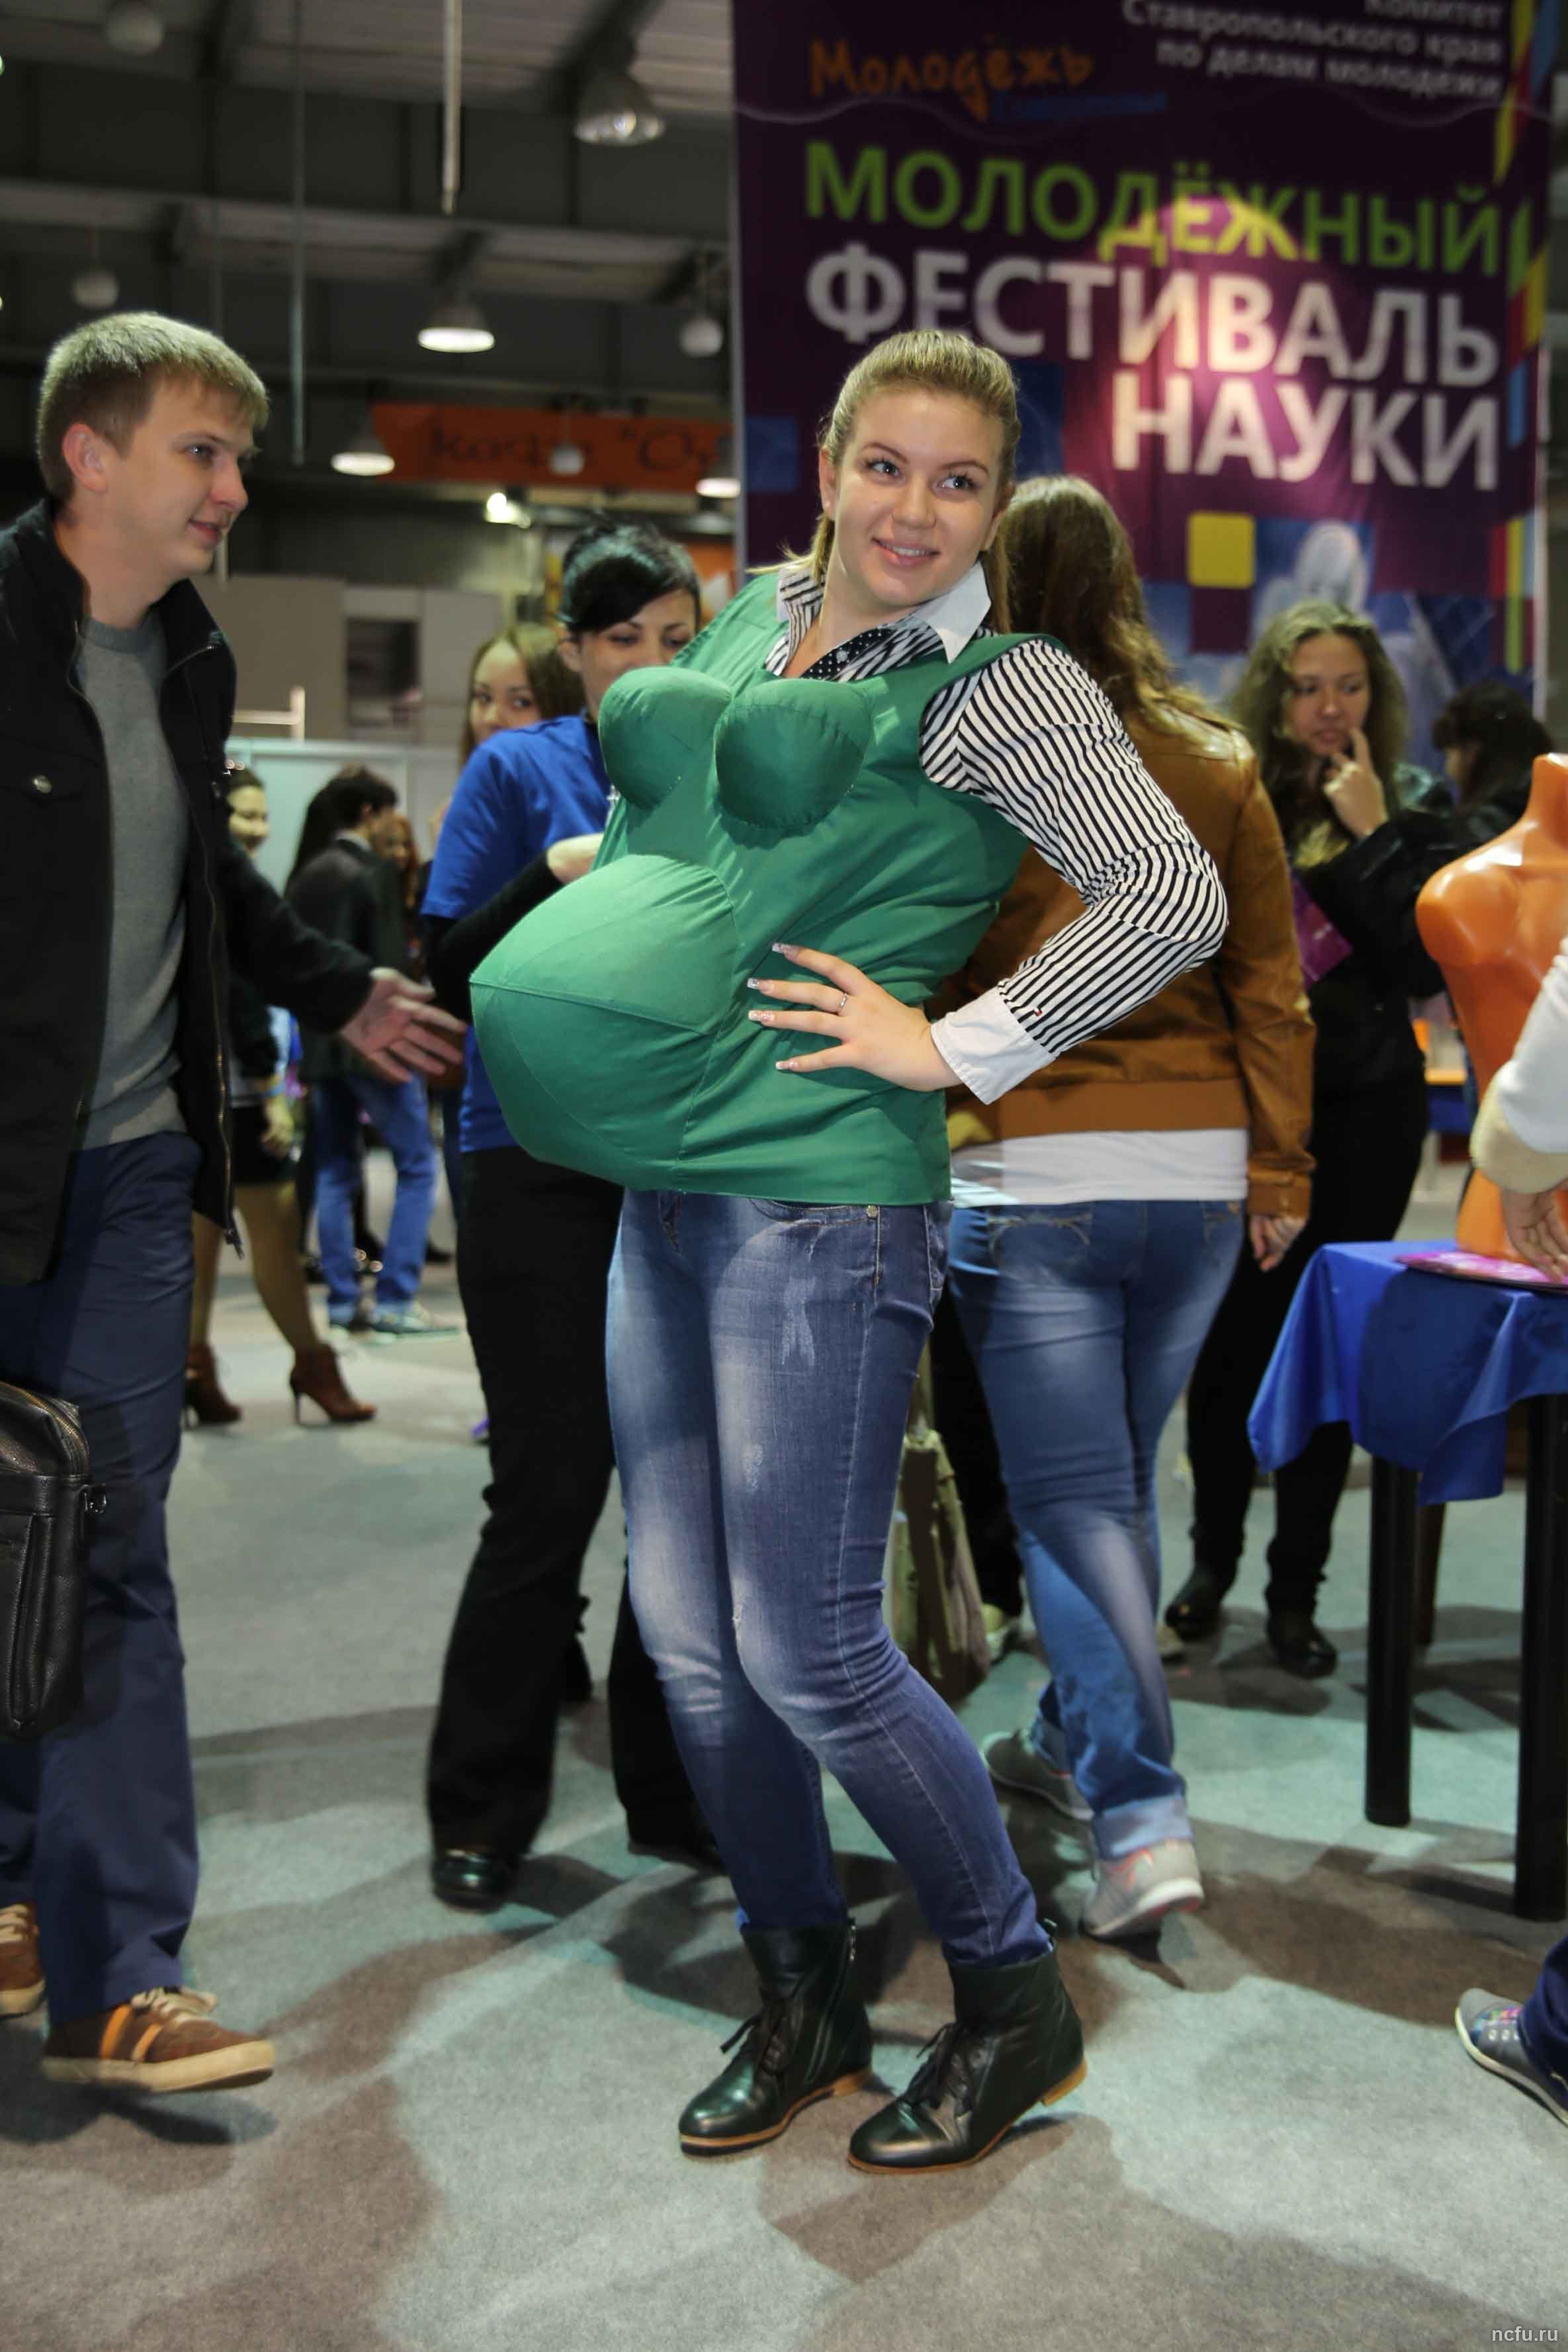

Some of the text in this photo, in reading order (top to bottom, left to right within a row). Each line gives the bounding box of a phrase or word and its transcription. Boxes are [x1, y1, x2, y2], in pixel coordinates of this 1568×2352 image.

[1122, 0, 1502, 65] Ставропольского края
[1156, 40, 1203, 67] по
[1206, 45, 1317, 79] делам
[805, 140, 1500, 276] МОЛОДЁЖНЫЙ
[805, 242, 1498, 386] ФЕСТИВАЛЬ
[1113, 371, 1497, 491] НАУКИ
